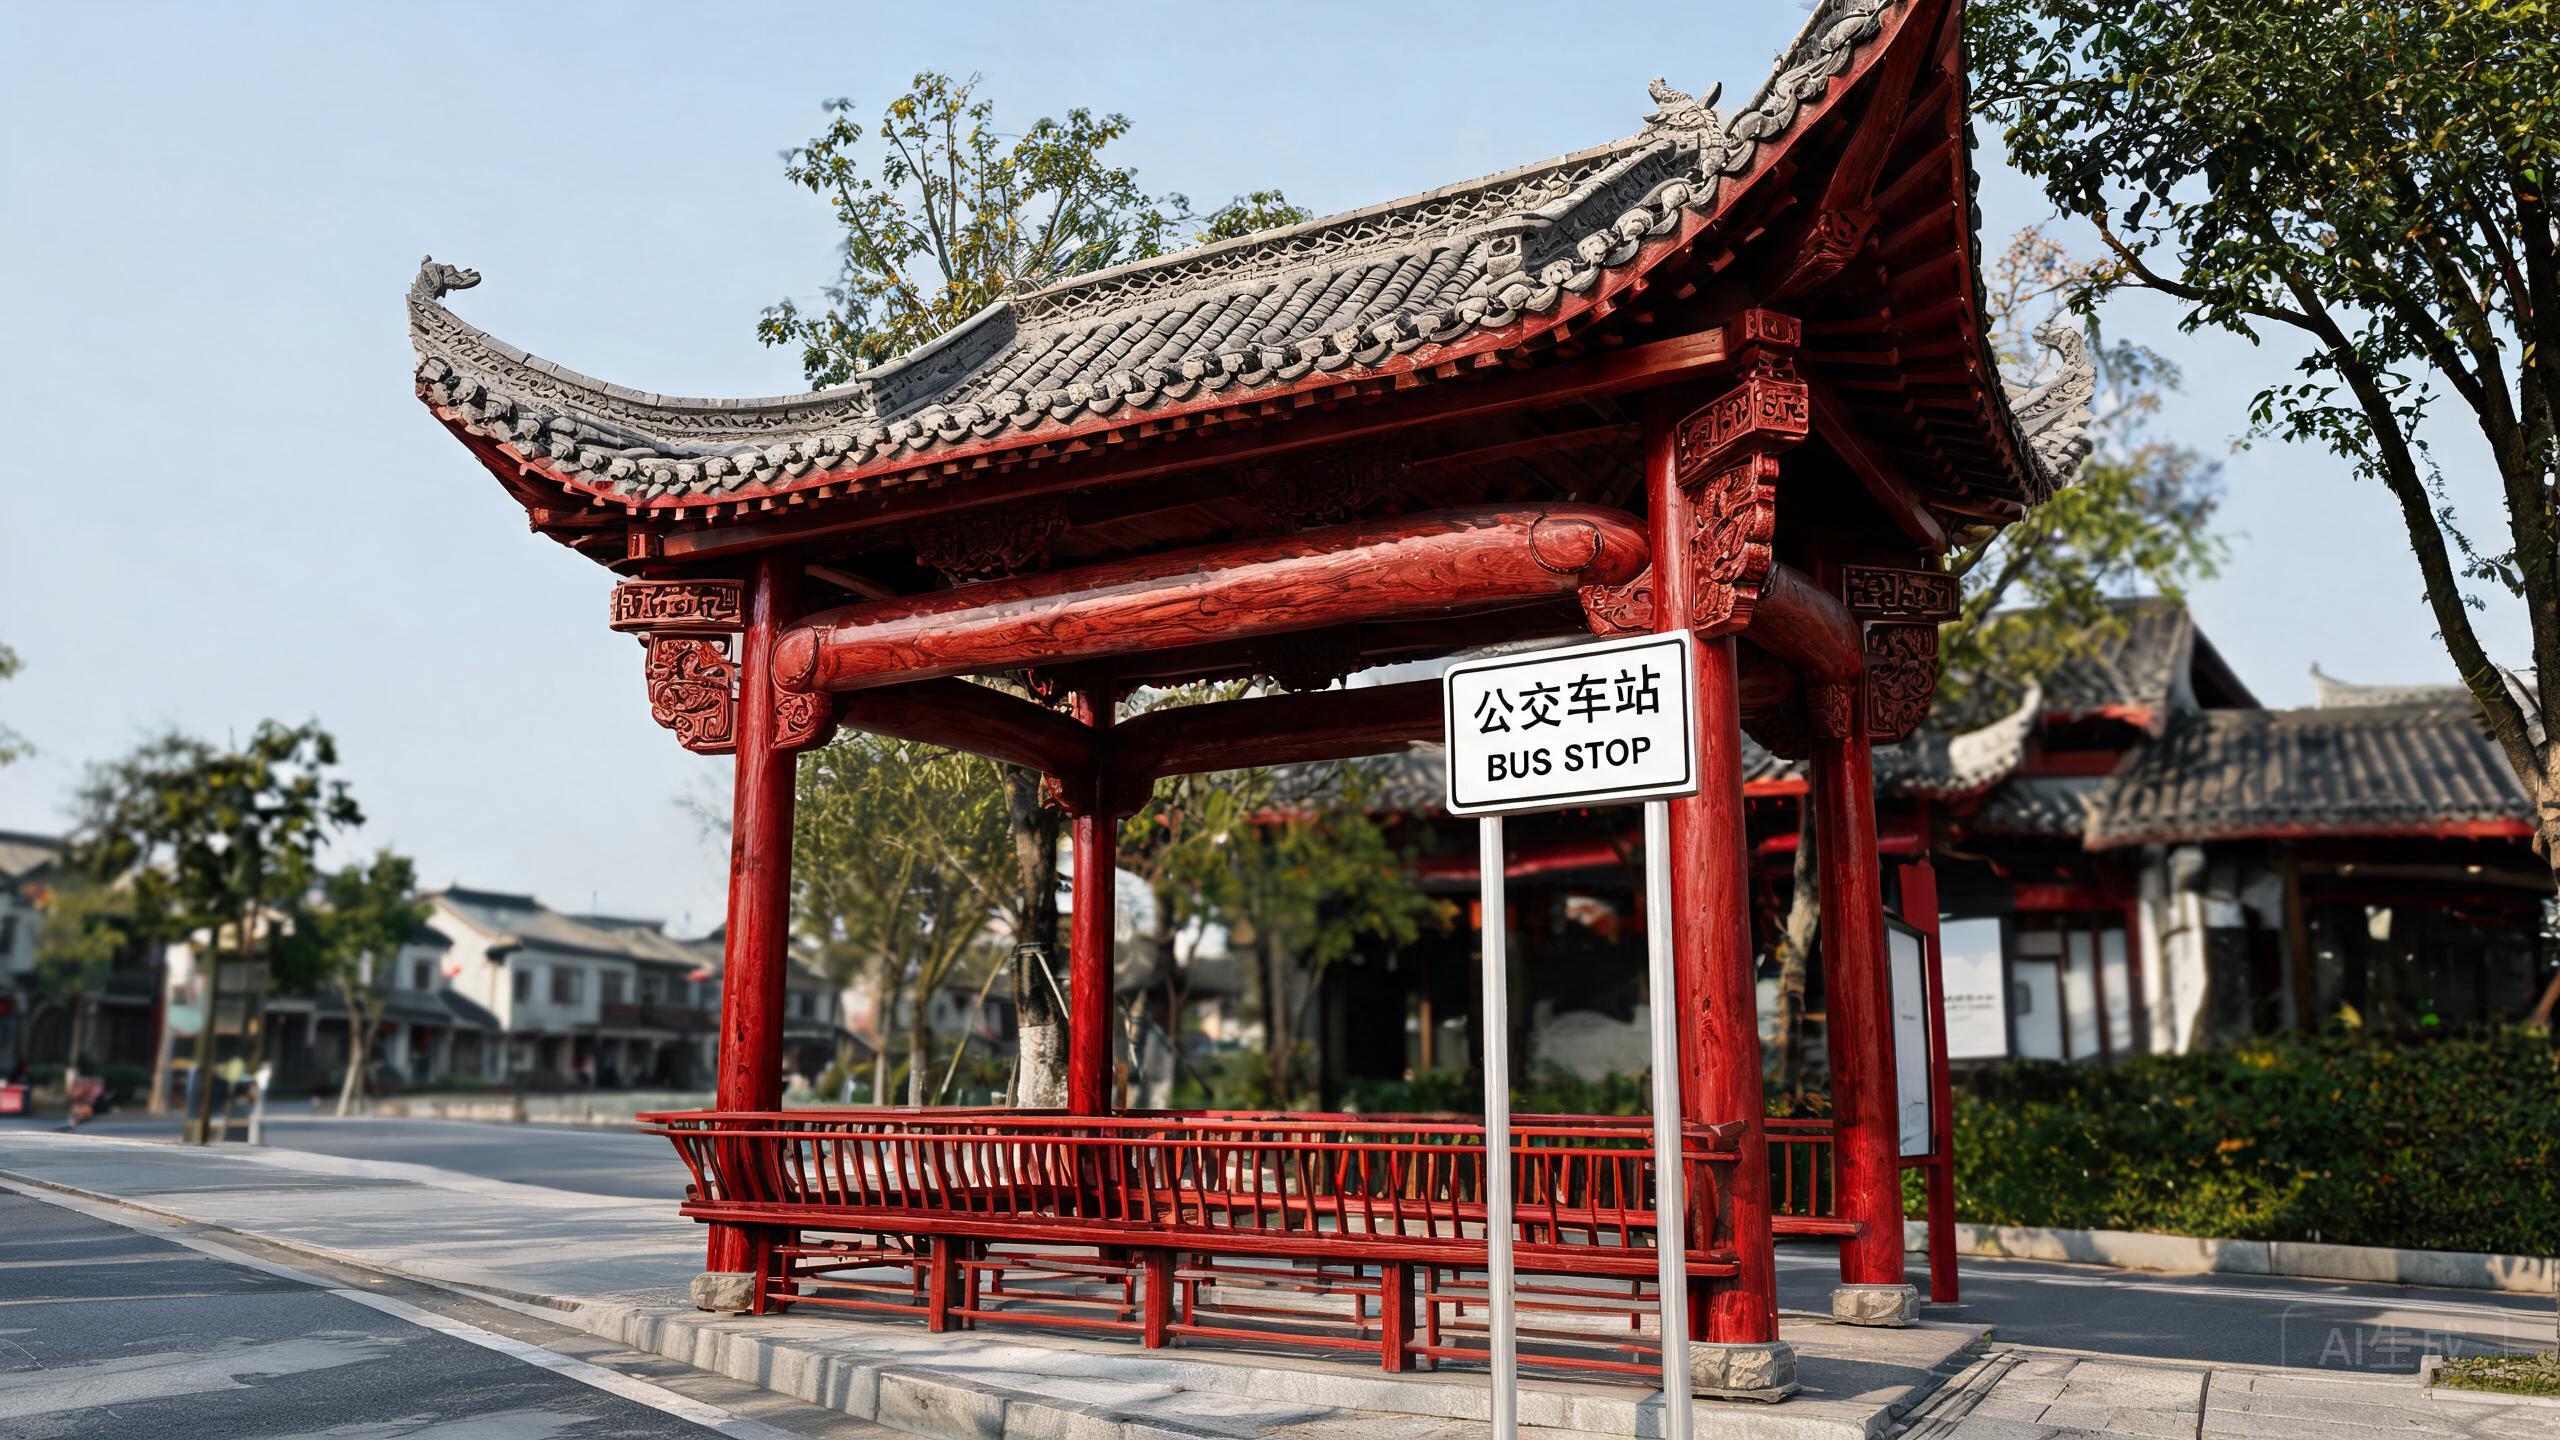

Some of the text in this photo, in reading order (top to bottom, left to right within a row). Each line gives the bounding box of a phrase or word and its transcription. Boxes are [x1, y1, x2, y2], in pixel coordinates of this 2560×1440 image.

[1475, 664, 1661, 734] 公交车站
[1488, 736, 1651, 782] BUS STOP
